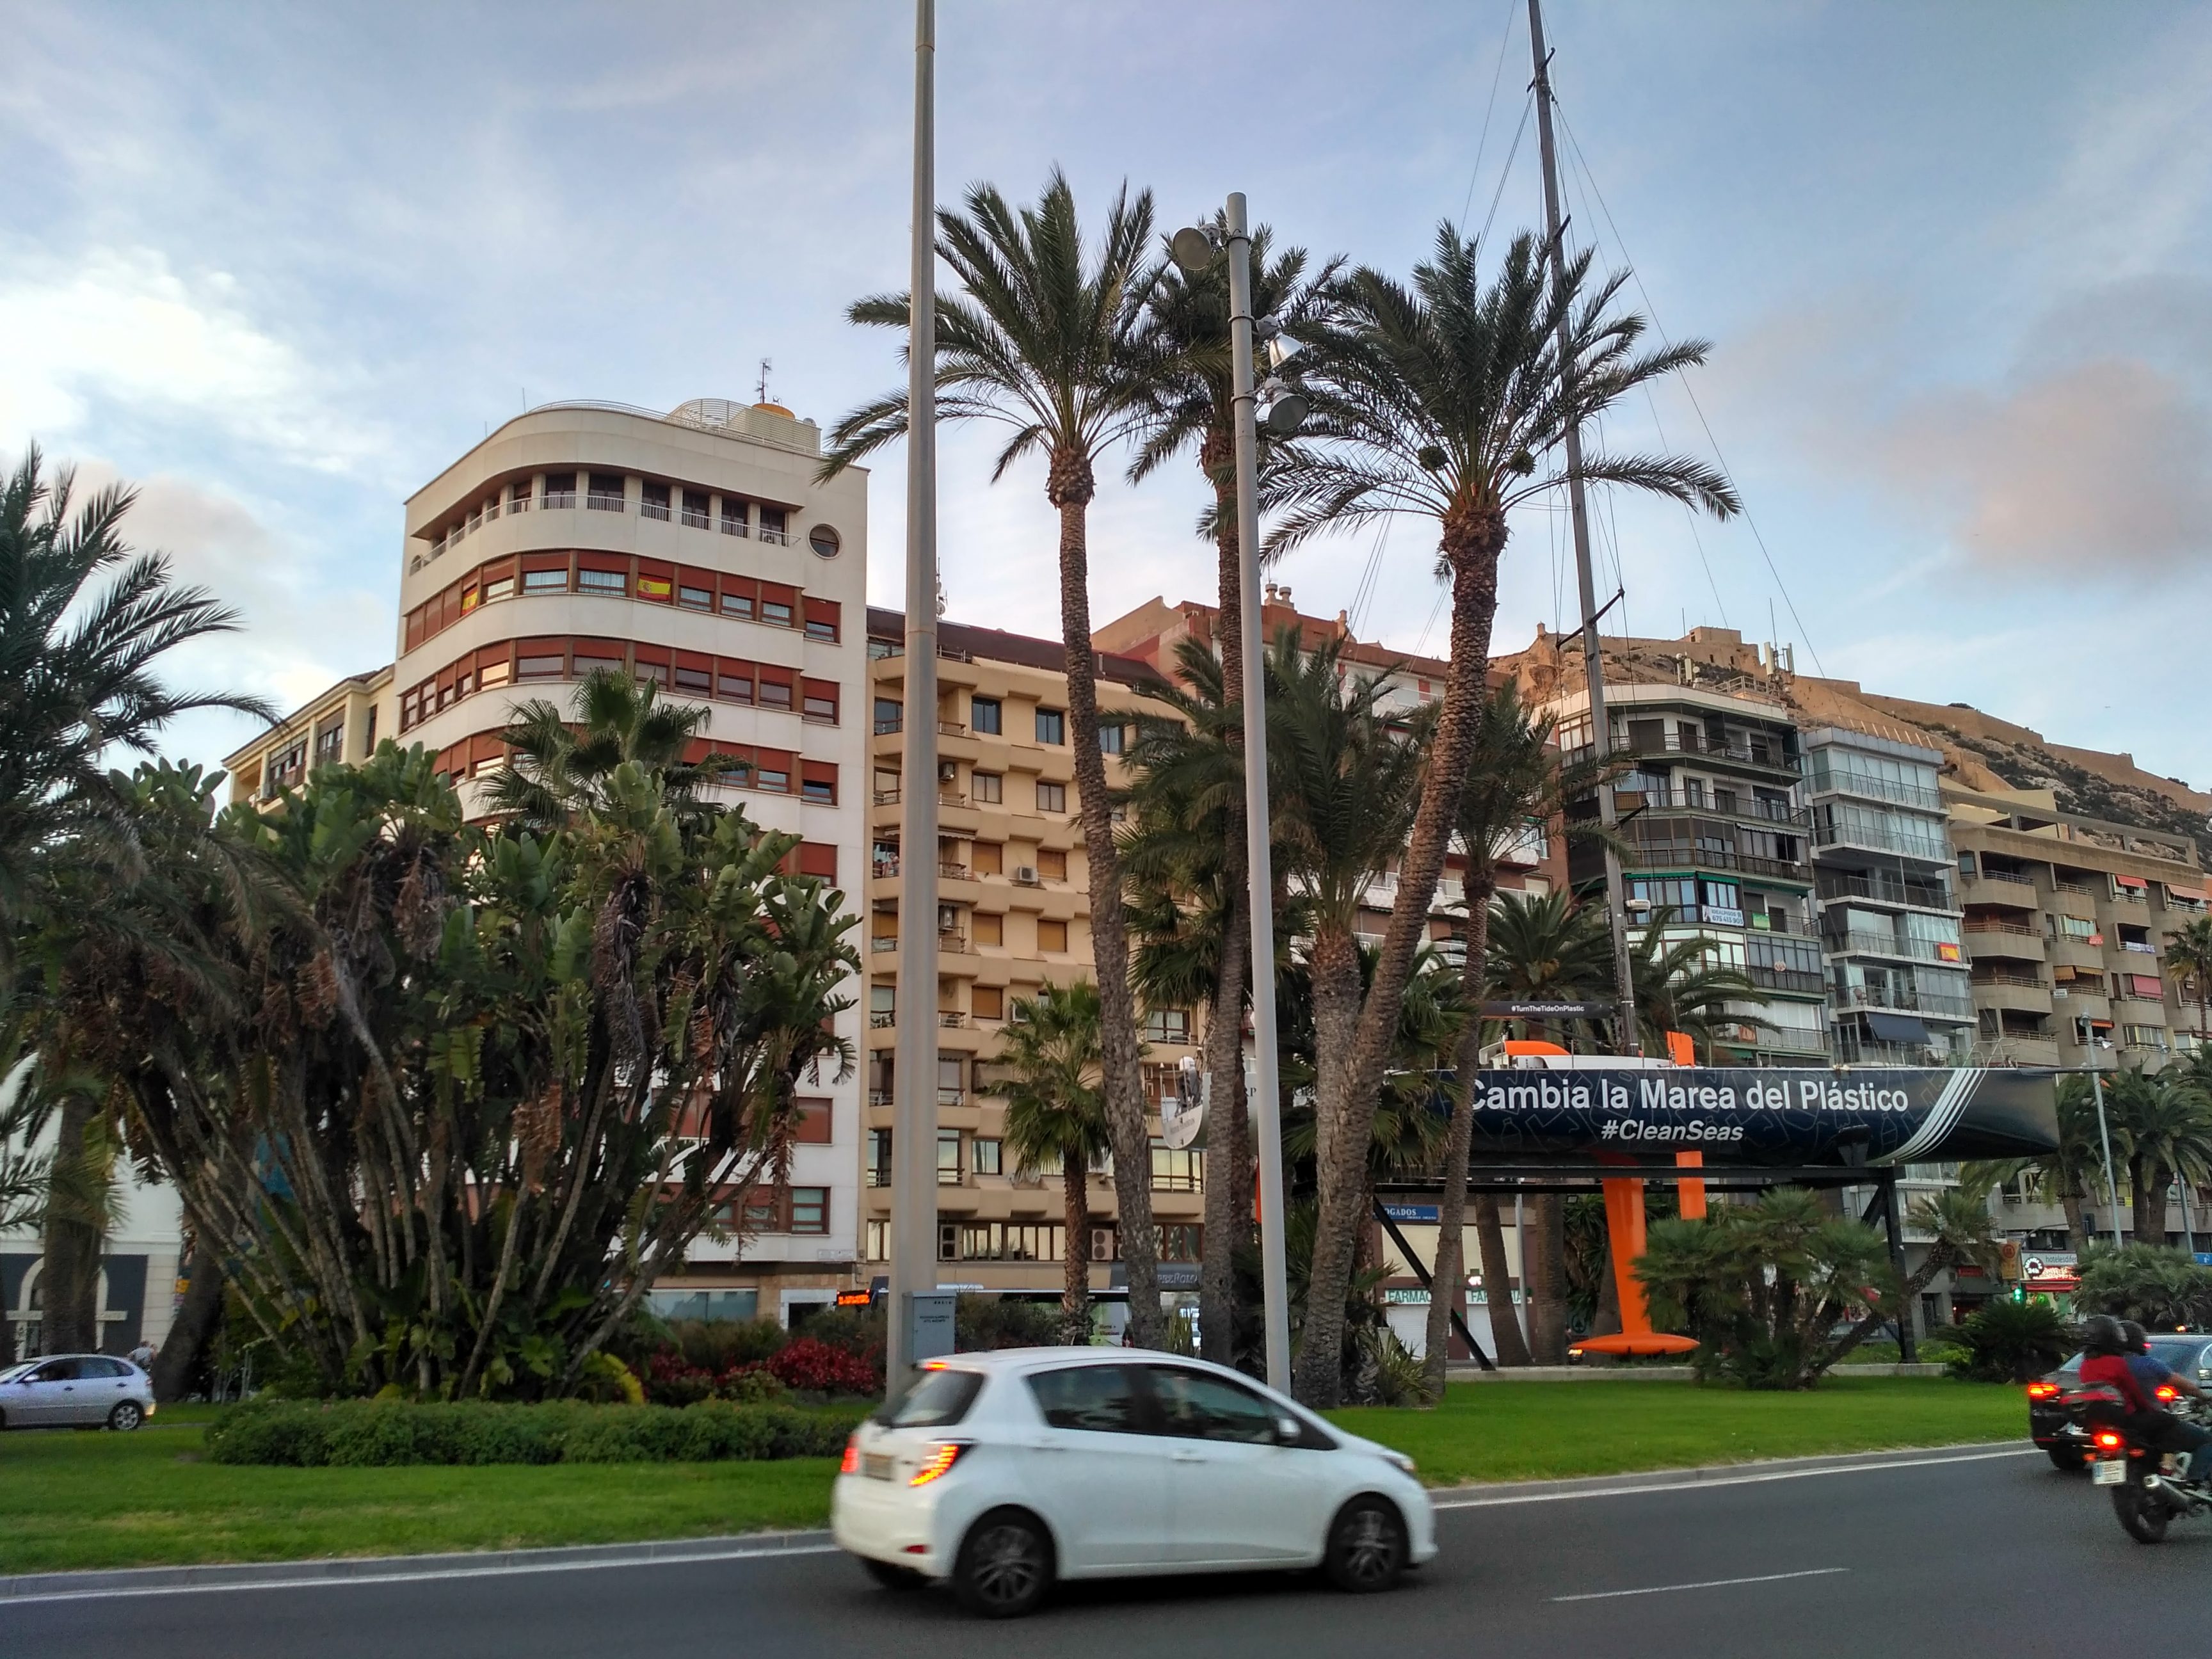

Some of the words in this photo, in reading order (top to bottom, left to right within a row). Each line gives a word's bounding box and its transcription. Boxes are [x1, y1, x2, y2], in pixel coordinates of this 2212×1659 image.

[1472, 1078, 1591, 1110] Cambia
[1601, 1078, 1629, 1109] la
[1640, 1078, 1736, 1110] Marea
[1746, 1080, 1790, 1110] del
[1800, 1080, 1908, 1112] Plástico
[1601, 1119, 1744, 1141] #CleanSeas
[1388, 1290, 1432, 1302] FARMAC
